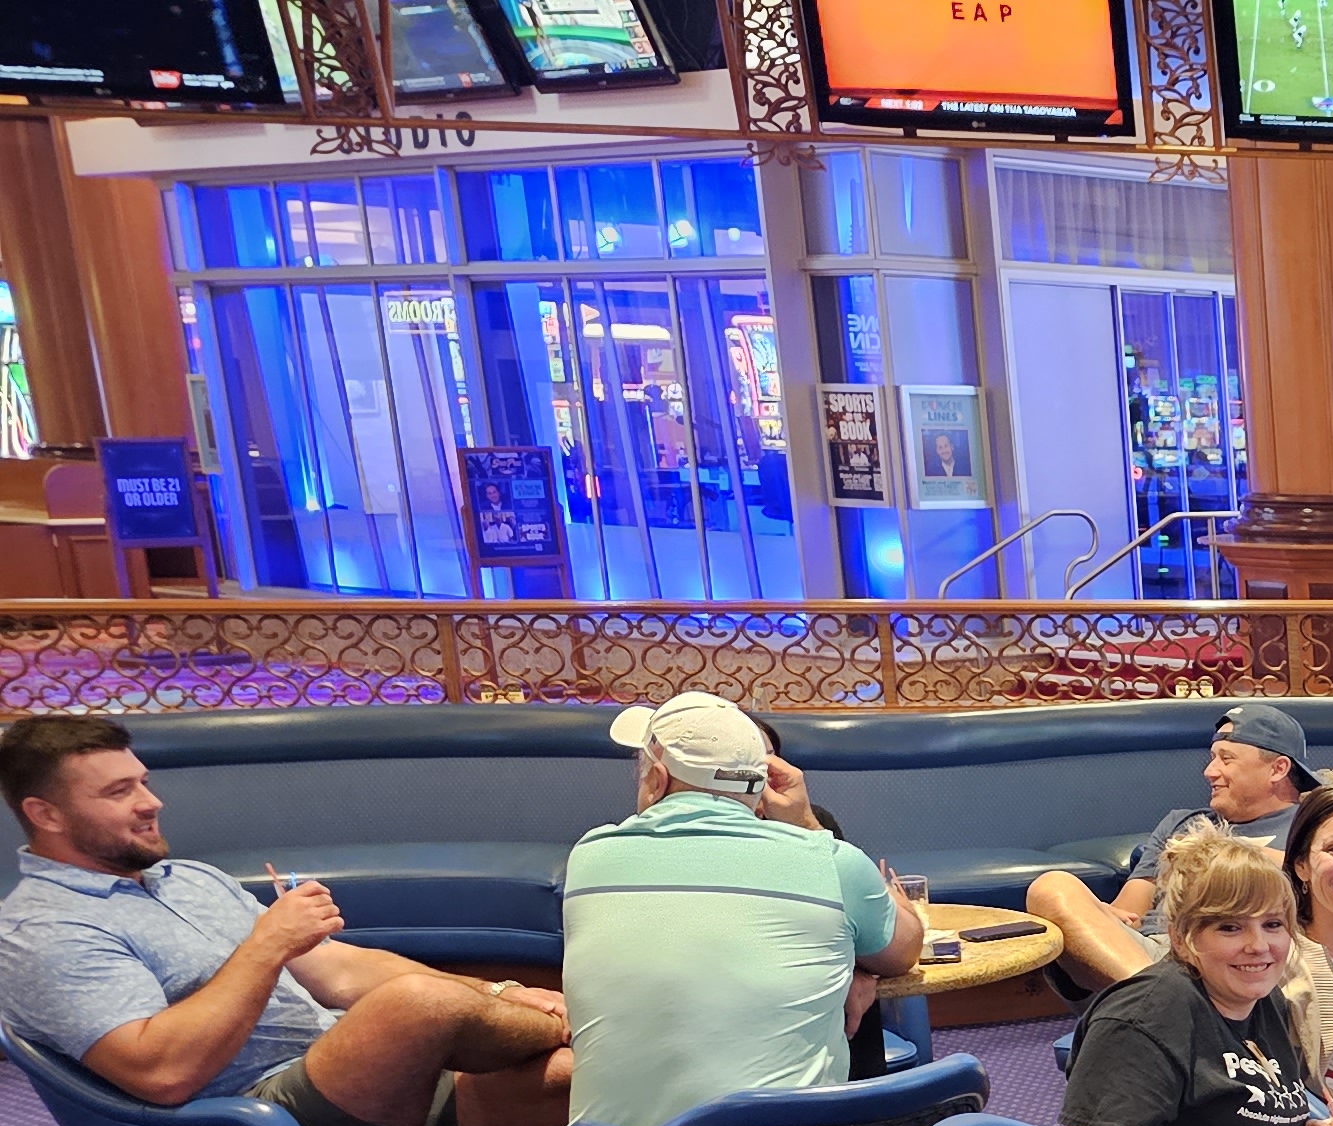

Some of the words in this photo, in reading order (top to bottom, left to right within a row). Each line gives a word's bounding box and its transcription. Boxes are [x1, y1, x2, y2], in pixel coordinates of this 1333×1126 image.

[829, 393, 875, 413] SPORTS
[839, 420, 873, 441] BOOK
[116, 478, 151, 492] MUST
[151, 478, 168, 492] BE
[168, 478, 181, 492] 21
[124, 492, 142, 507] OR
[142, 491, 179, 506] OLDER
[1237, 1106, 1270, 1122] Absolute
